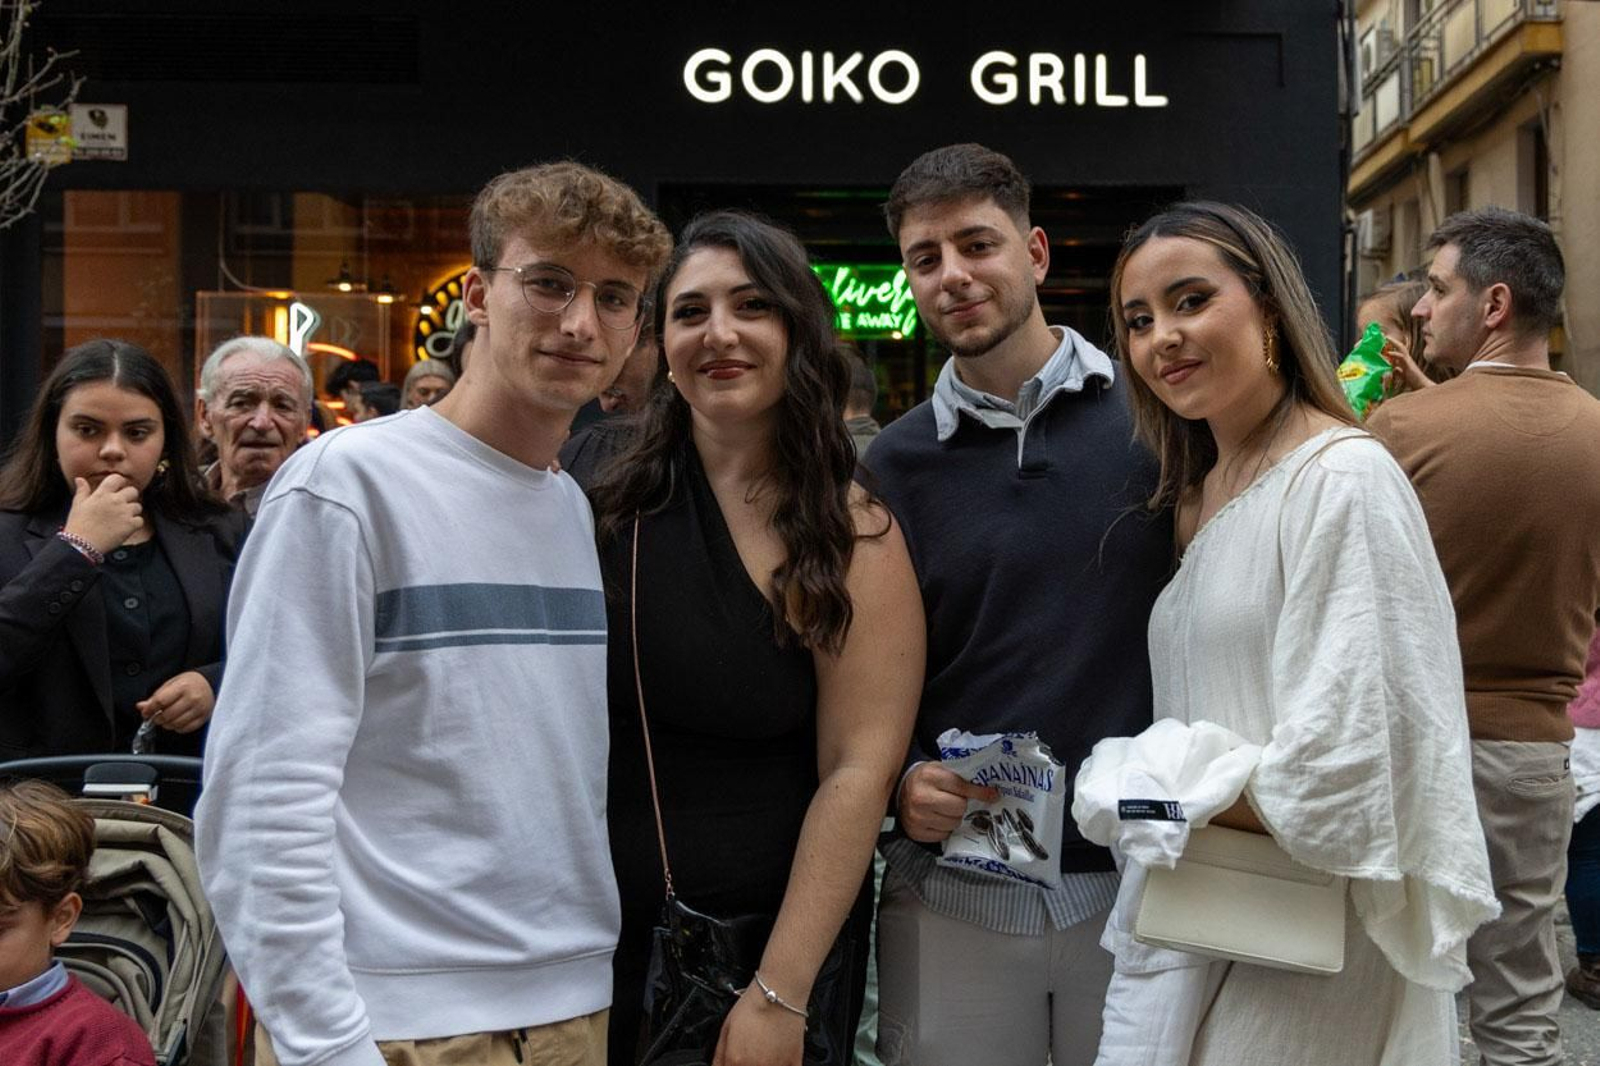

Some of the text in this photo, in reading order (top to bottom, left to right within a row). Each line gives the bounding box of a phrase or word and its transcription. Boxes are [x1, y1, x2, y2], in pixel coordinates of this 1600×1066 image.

[684, 48, 1168, 106] GOIKO GRILL
[856, 312, 904, 329] AWAY
